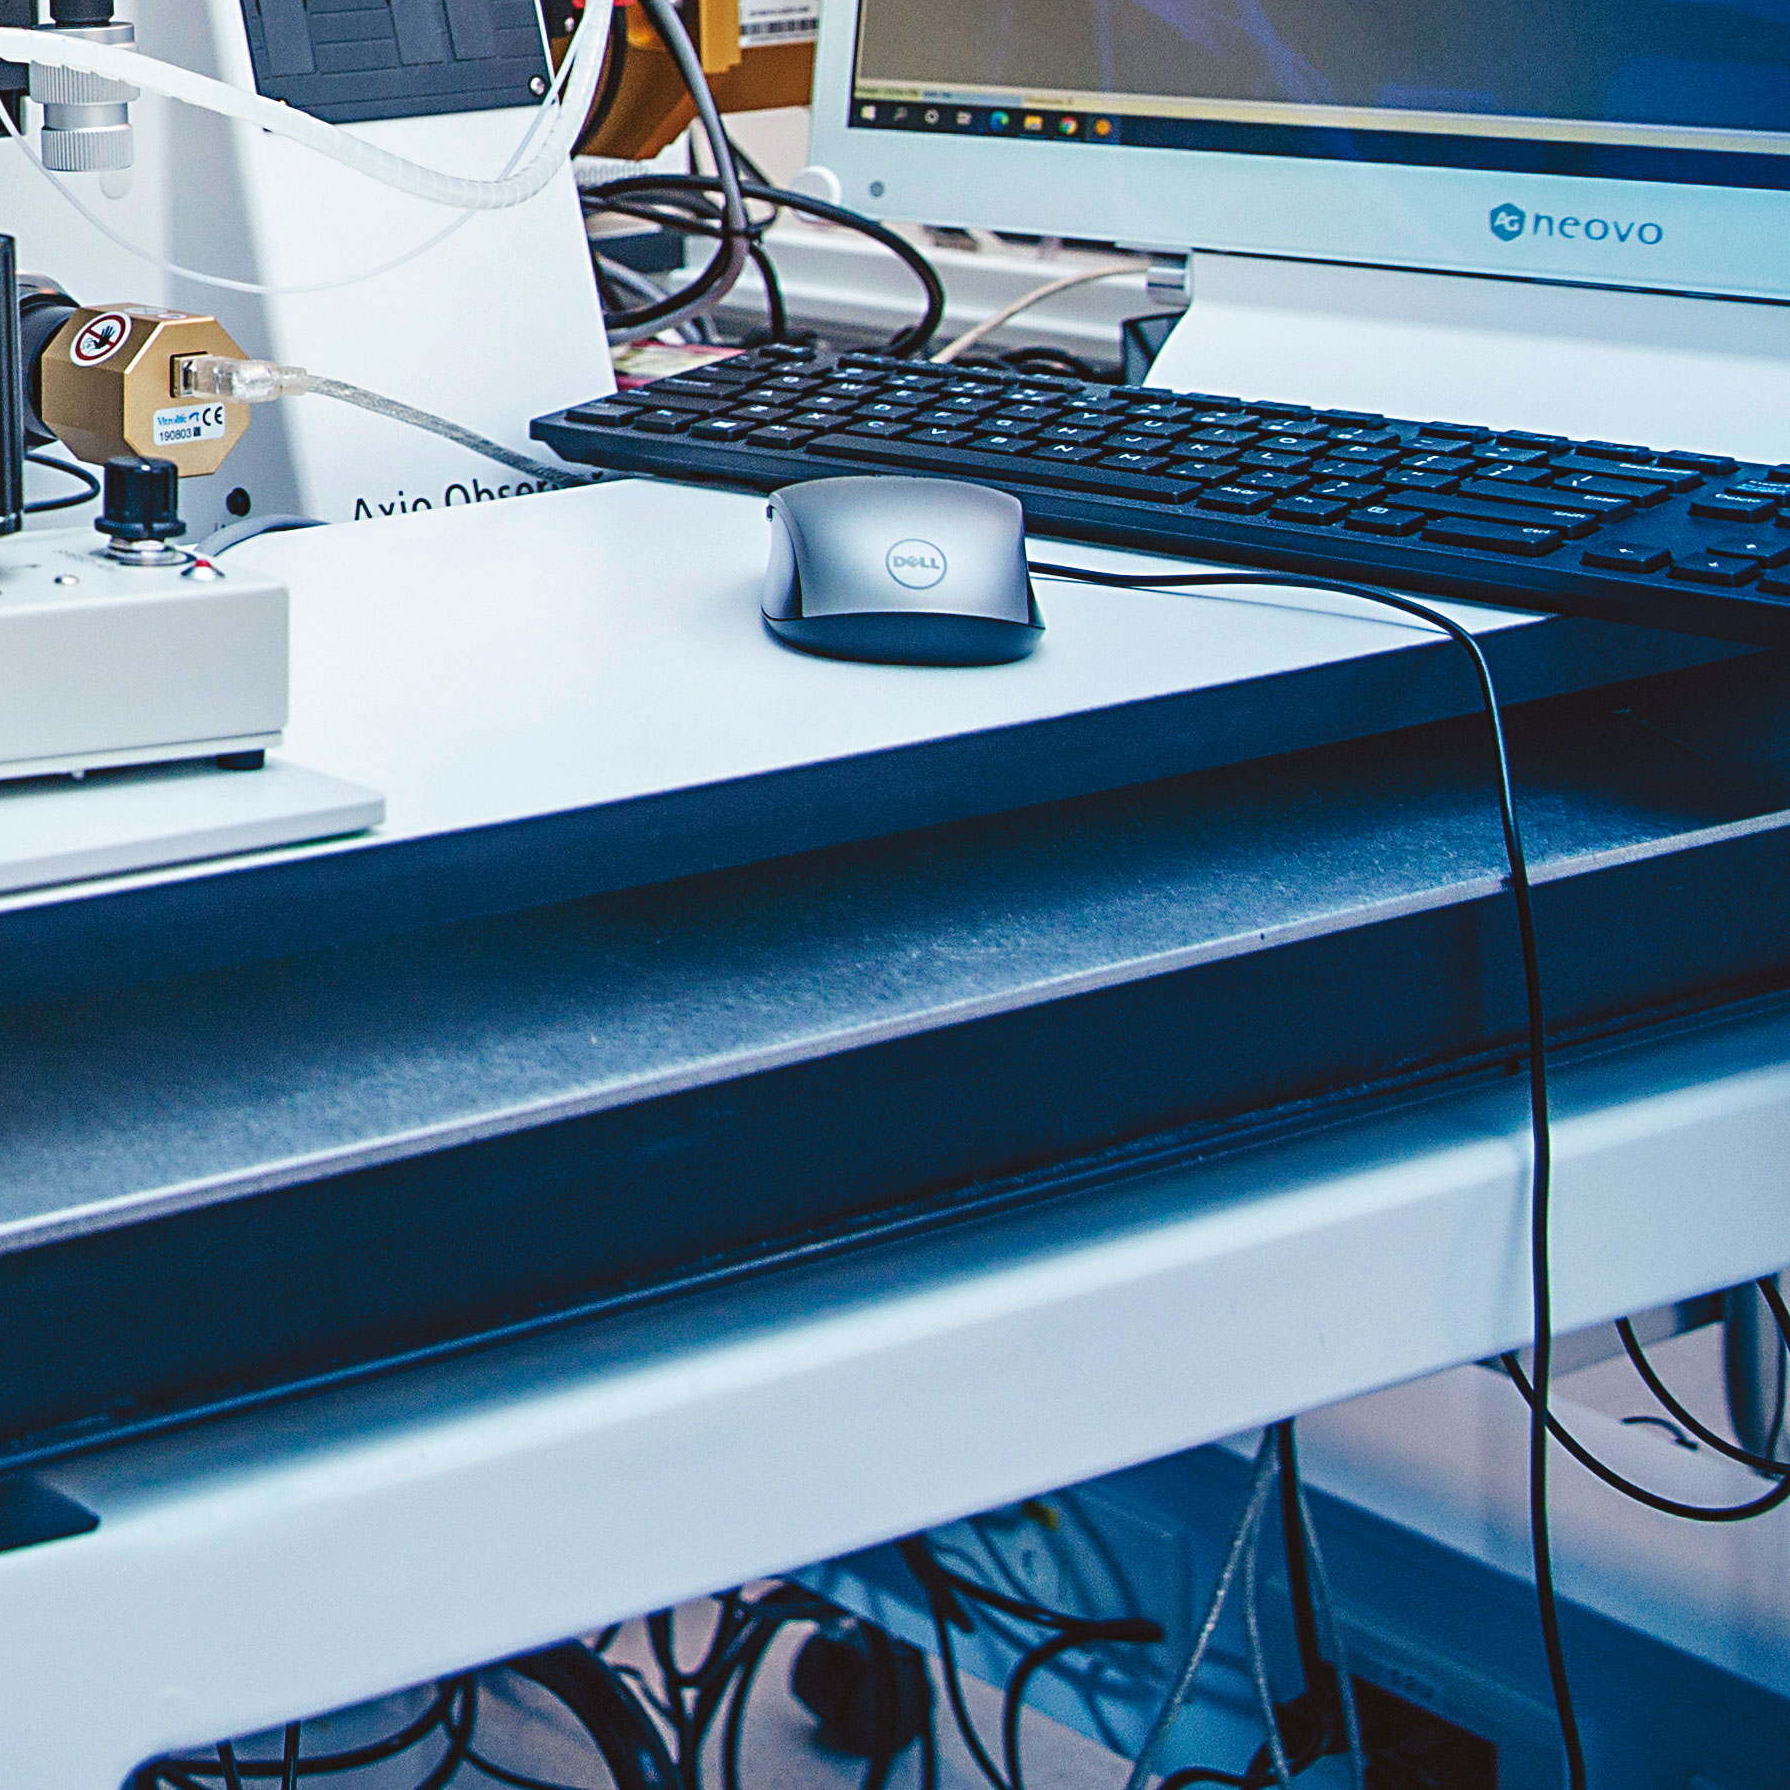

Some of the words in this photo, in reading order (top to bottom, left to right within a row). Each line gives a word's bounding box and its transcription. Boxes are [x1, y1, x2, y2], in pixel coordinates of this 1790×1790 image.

[1533, 212, 1664, 245] neovo
[202, 406, 223, 427] CE
[159, 428, 192, 442] 190803
[892, 555, 941, 570] DELL
